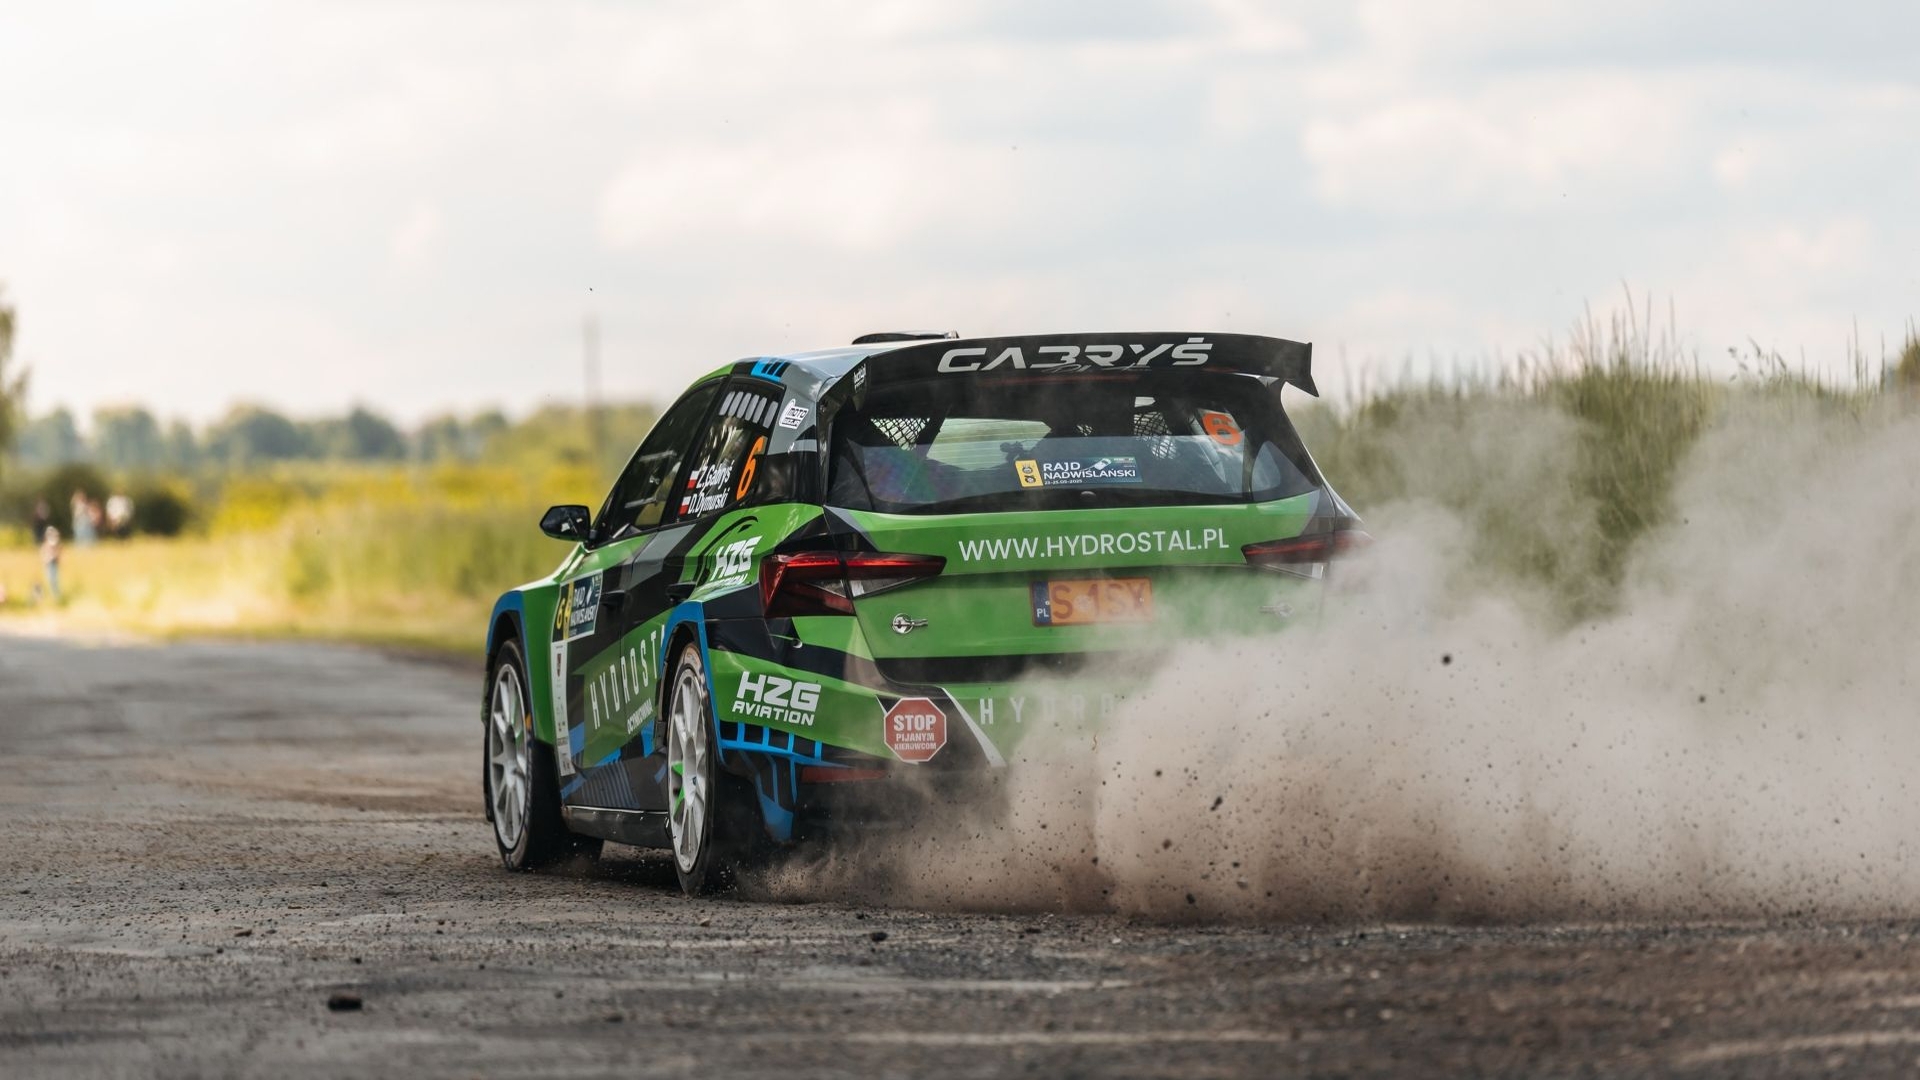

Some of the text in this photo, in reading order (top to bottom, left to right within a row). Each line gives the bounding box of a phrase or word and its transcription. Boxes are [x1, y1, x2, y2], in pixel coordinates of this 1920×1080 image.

[1202, 413, 1243, 446] 6
[736, 435, 765, 501] 6
[1043, 461, 1081, 472] RAJD
[1043, 468, 1136, 480] NADWIŚLAŃSKI
[958, 528, 1229, 561] WWW.HYDROSTAL.PL
[710, 536, 763, 581] HZG
[556, 597, 566, 630] 6
[1036, 608, 1050, 618] PL
[736, 671, 822, 712] HZG
[732, 700, 815, 726] AVIATION
[893, 714, 937, 731] STOP
[894, 742, 937, 751] KIEROWCOM
[895, 732, 935, 742] PIJANYM
